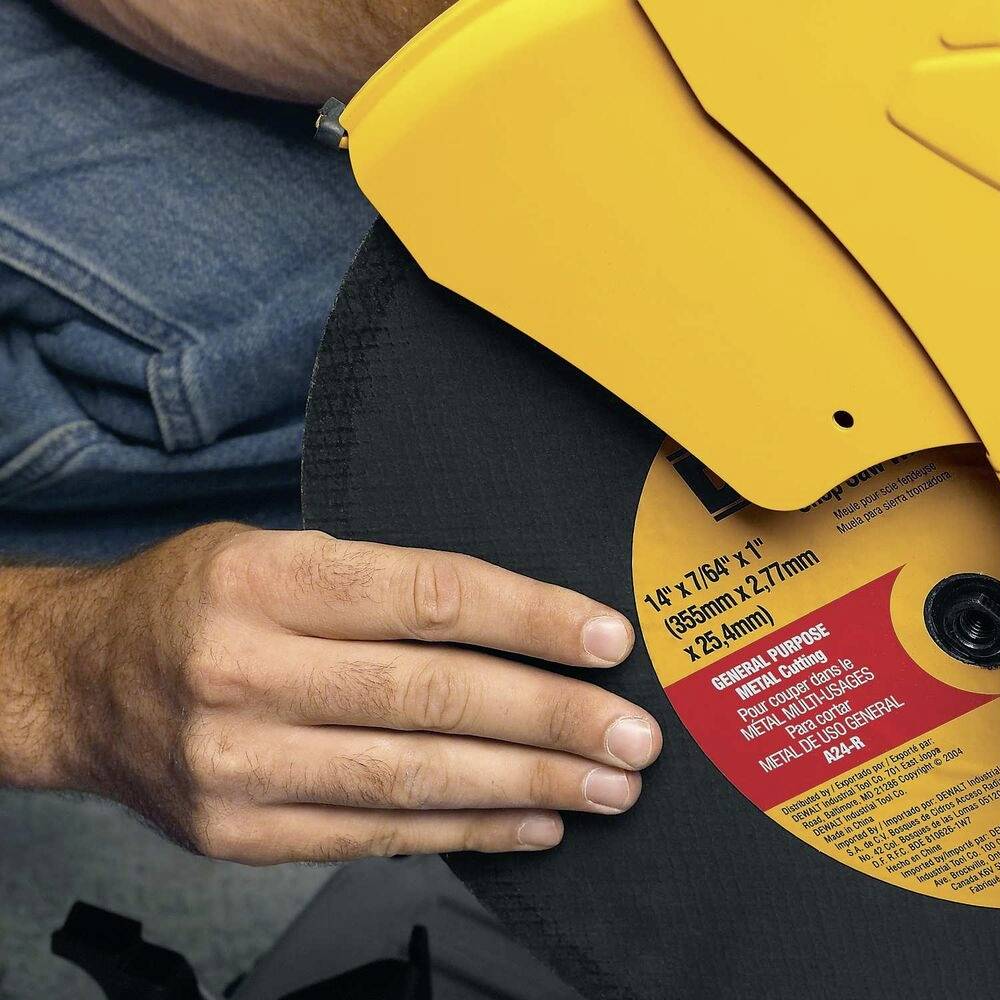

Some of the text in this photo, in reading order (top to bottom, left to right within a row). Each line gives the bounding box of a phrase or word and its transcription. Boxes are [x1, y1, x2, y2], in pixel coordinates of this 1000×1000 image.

[832, 462, 937, 520] Meule pour scie fendeuse
[836, 470, 952, 534] Muela para sierra tronzadora
[644, 538, 763, 612] 14" x 7/64" x 1"
[664, 549, 820, 639] (355mm x 2,77mm
[683, 605, 775, 662] x 25,4mm)
[711, 623, 830, 690] GENERAL PURPOSE
[735, 650, 828, 700] METAL Cutting
[737, 658, 854, 722] Pour couper dans le
[740, 667, 875, 741] MÉTAL MULTI-USAGES
[758, 695, 905, 773] METAL DE USO GENERAL
[785, 700, 852, 739] Para cortar
[782, 793, 820, 816] Distributed
[821, 787, 831, 798] by
[835, 769, 872, 789] Exportado
[872, 762, 886, 775] por
[890, 745, 918, 763] Exporté
[918, 738, 935, 751] par:
[822, 735, 866, 764] A24-R
[860, 790, 874, 802] MD
[874, 779, 899, 796] 21286
[898, 763, 934, 784] Copyright
[943, 747, 964, 762] 2004
[791, 747, 942, 823] DEWALT Industrial Tool Co. 701 East Joppa
[813, 789, 908, 837] DEWALT Industrial Tool Co.
[823, 816, 875, 844] Made in China
[834, 829, 869, 851] Imported
[868, 825, 879, 837] By
[883, 806, 921, 828] Importado
[921, 798, 935, 811] por:
[936, 783, 968, 802] DEWALT
[858, 853, 874, 863] No.
[873, 845, 884, 856] 42
[883, 839, 900, 852] Col.
[899, 824, 931, 844] Bosques
[932, 820, 942, 830] de
[943, 813, 954, 824] las
[953, 801, 979, 818] Lomas
[864, 839, 874, 849] de
[888, 814, 920, 838] Bosques
[920, 811, 931, 821] de
[930, 801, 955, 817] Cidros
[955, 788, 983, 805] Acceso
[886, 859, 911, 874] Hecho
[910, 852, 922, 861] en
[901, 856, 936, 879] Imported
[975, 834, 990, 847] par:
[916, 862, 951, 883] Industrial
[950, 854, 967, 868] Tool
[967, 850, 981, 860] Co.
[981, 840, 996, 852] 100
[950, 872, 979, 892] Canada
